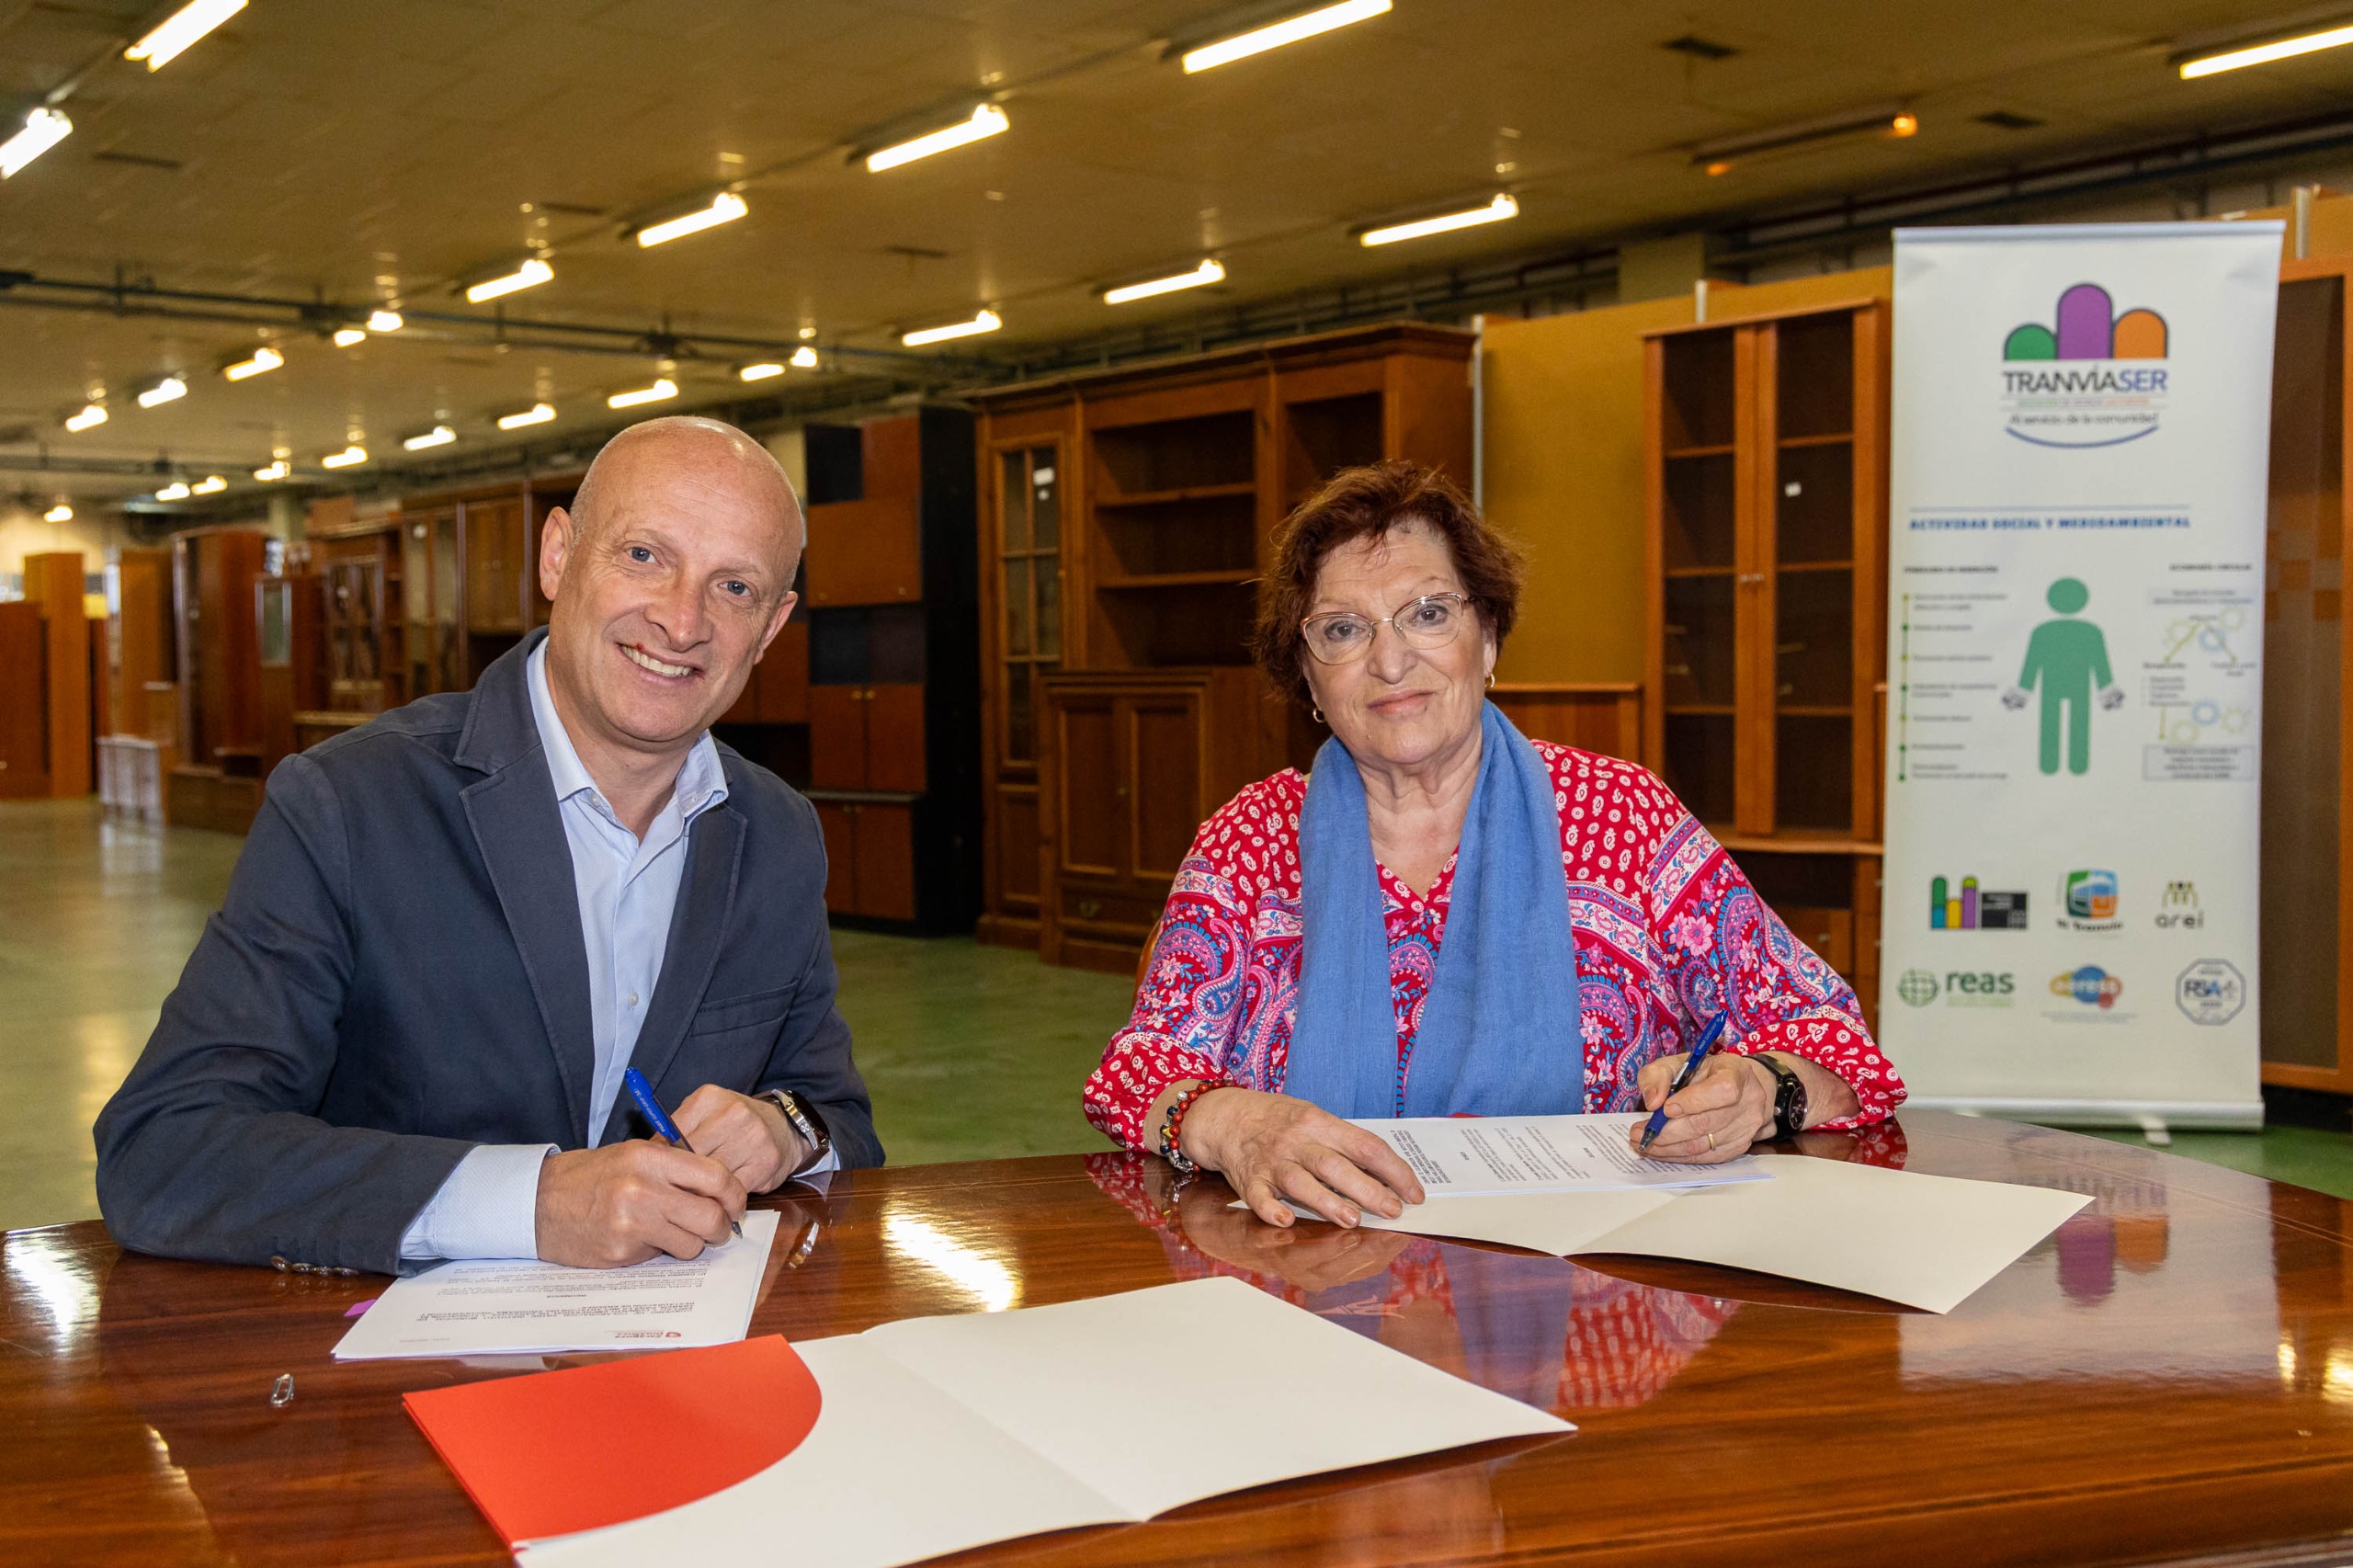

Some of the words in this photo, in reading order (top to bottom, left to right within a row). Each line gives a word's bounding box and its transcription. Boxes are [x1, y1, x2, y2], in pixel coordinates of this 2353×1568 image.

[2003, 363, 2168, 393] TRANVÍASER
[2067, 415, 2078, 425] de
[2095, 413, 2159, 425] comunidad
[1909, 518, 1987, 530] ACTIVIDAD
[1992, 517, 2040, 529] SOCIAL
[2046, 517, 2053, 528] Y
[2059, 517, 2191, 528] MEDIOAMBIENTAL
[1946, 971, 2016, 994] reas
